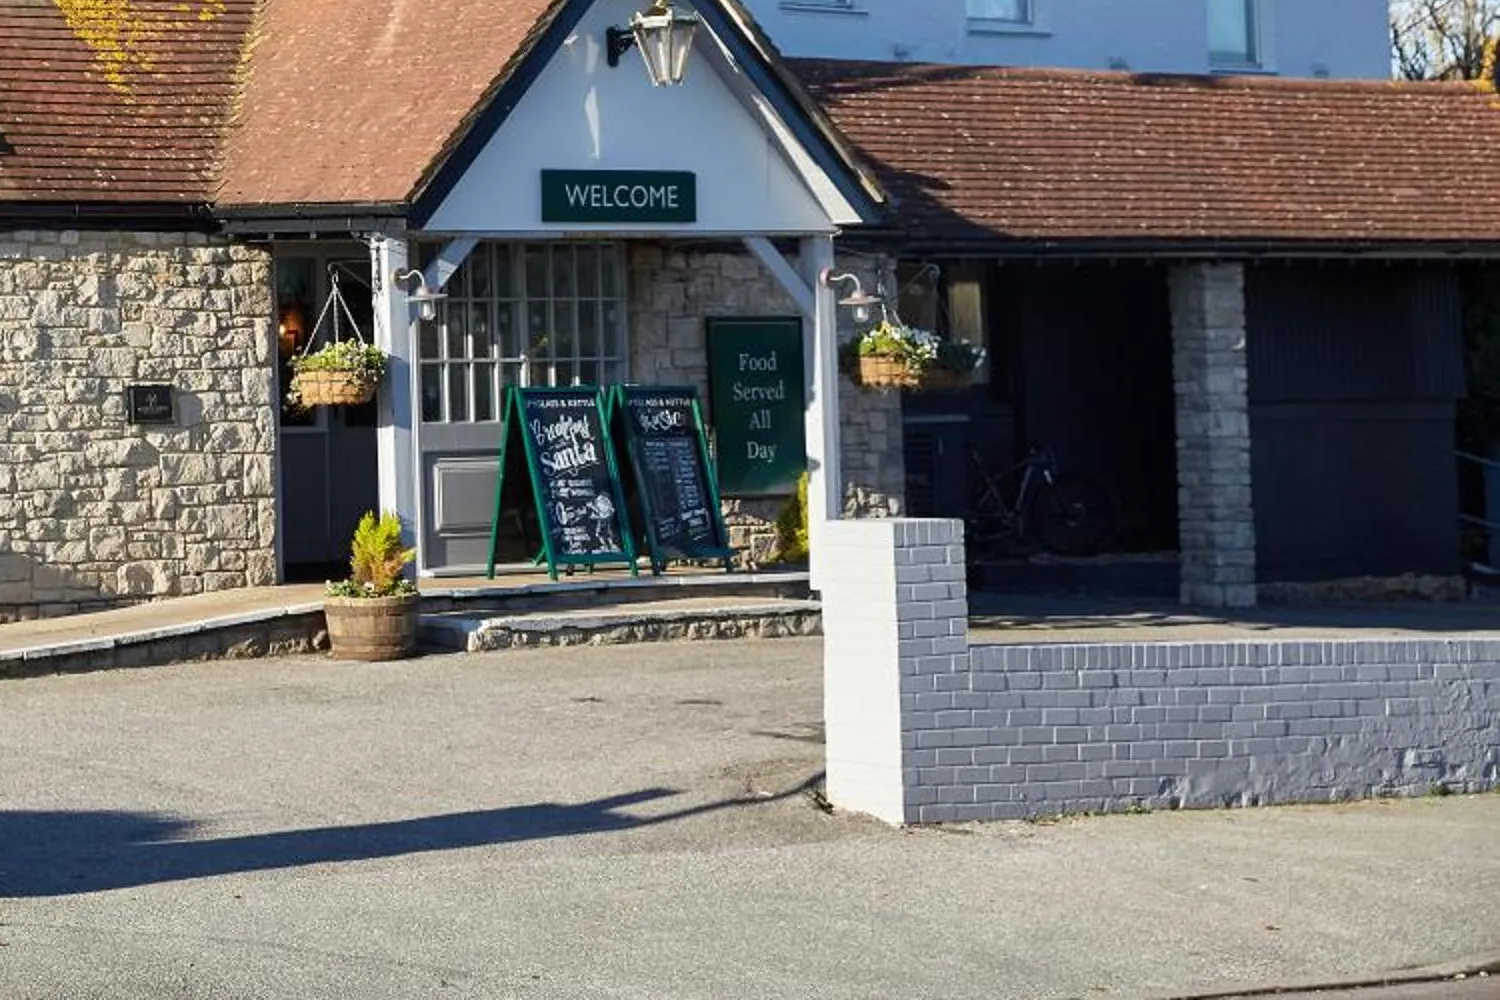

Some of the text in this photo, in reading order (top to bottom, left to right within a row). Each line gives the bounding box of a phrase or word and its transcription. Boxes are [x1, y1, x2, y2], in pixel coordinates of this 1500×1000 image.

[565, 184, 679, 208] WELCOME
[739, 351, 777, 371] Food
[733, 379, 785, 400] Served
[749, 409, 771, 429] All
[541, 432, 598, 477] Santa
[747, 441, 777, 463] Day
